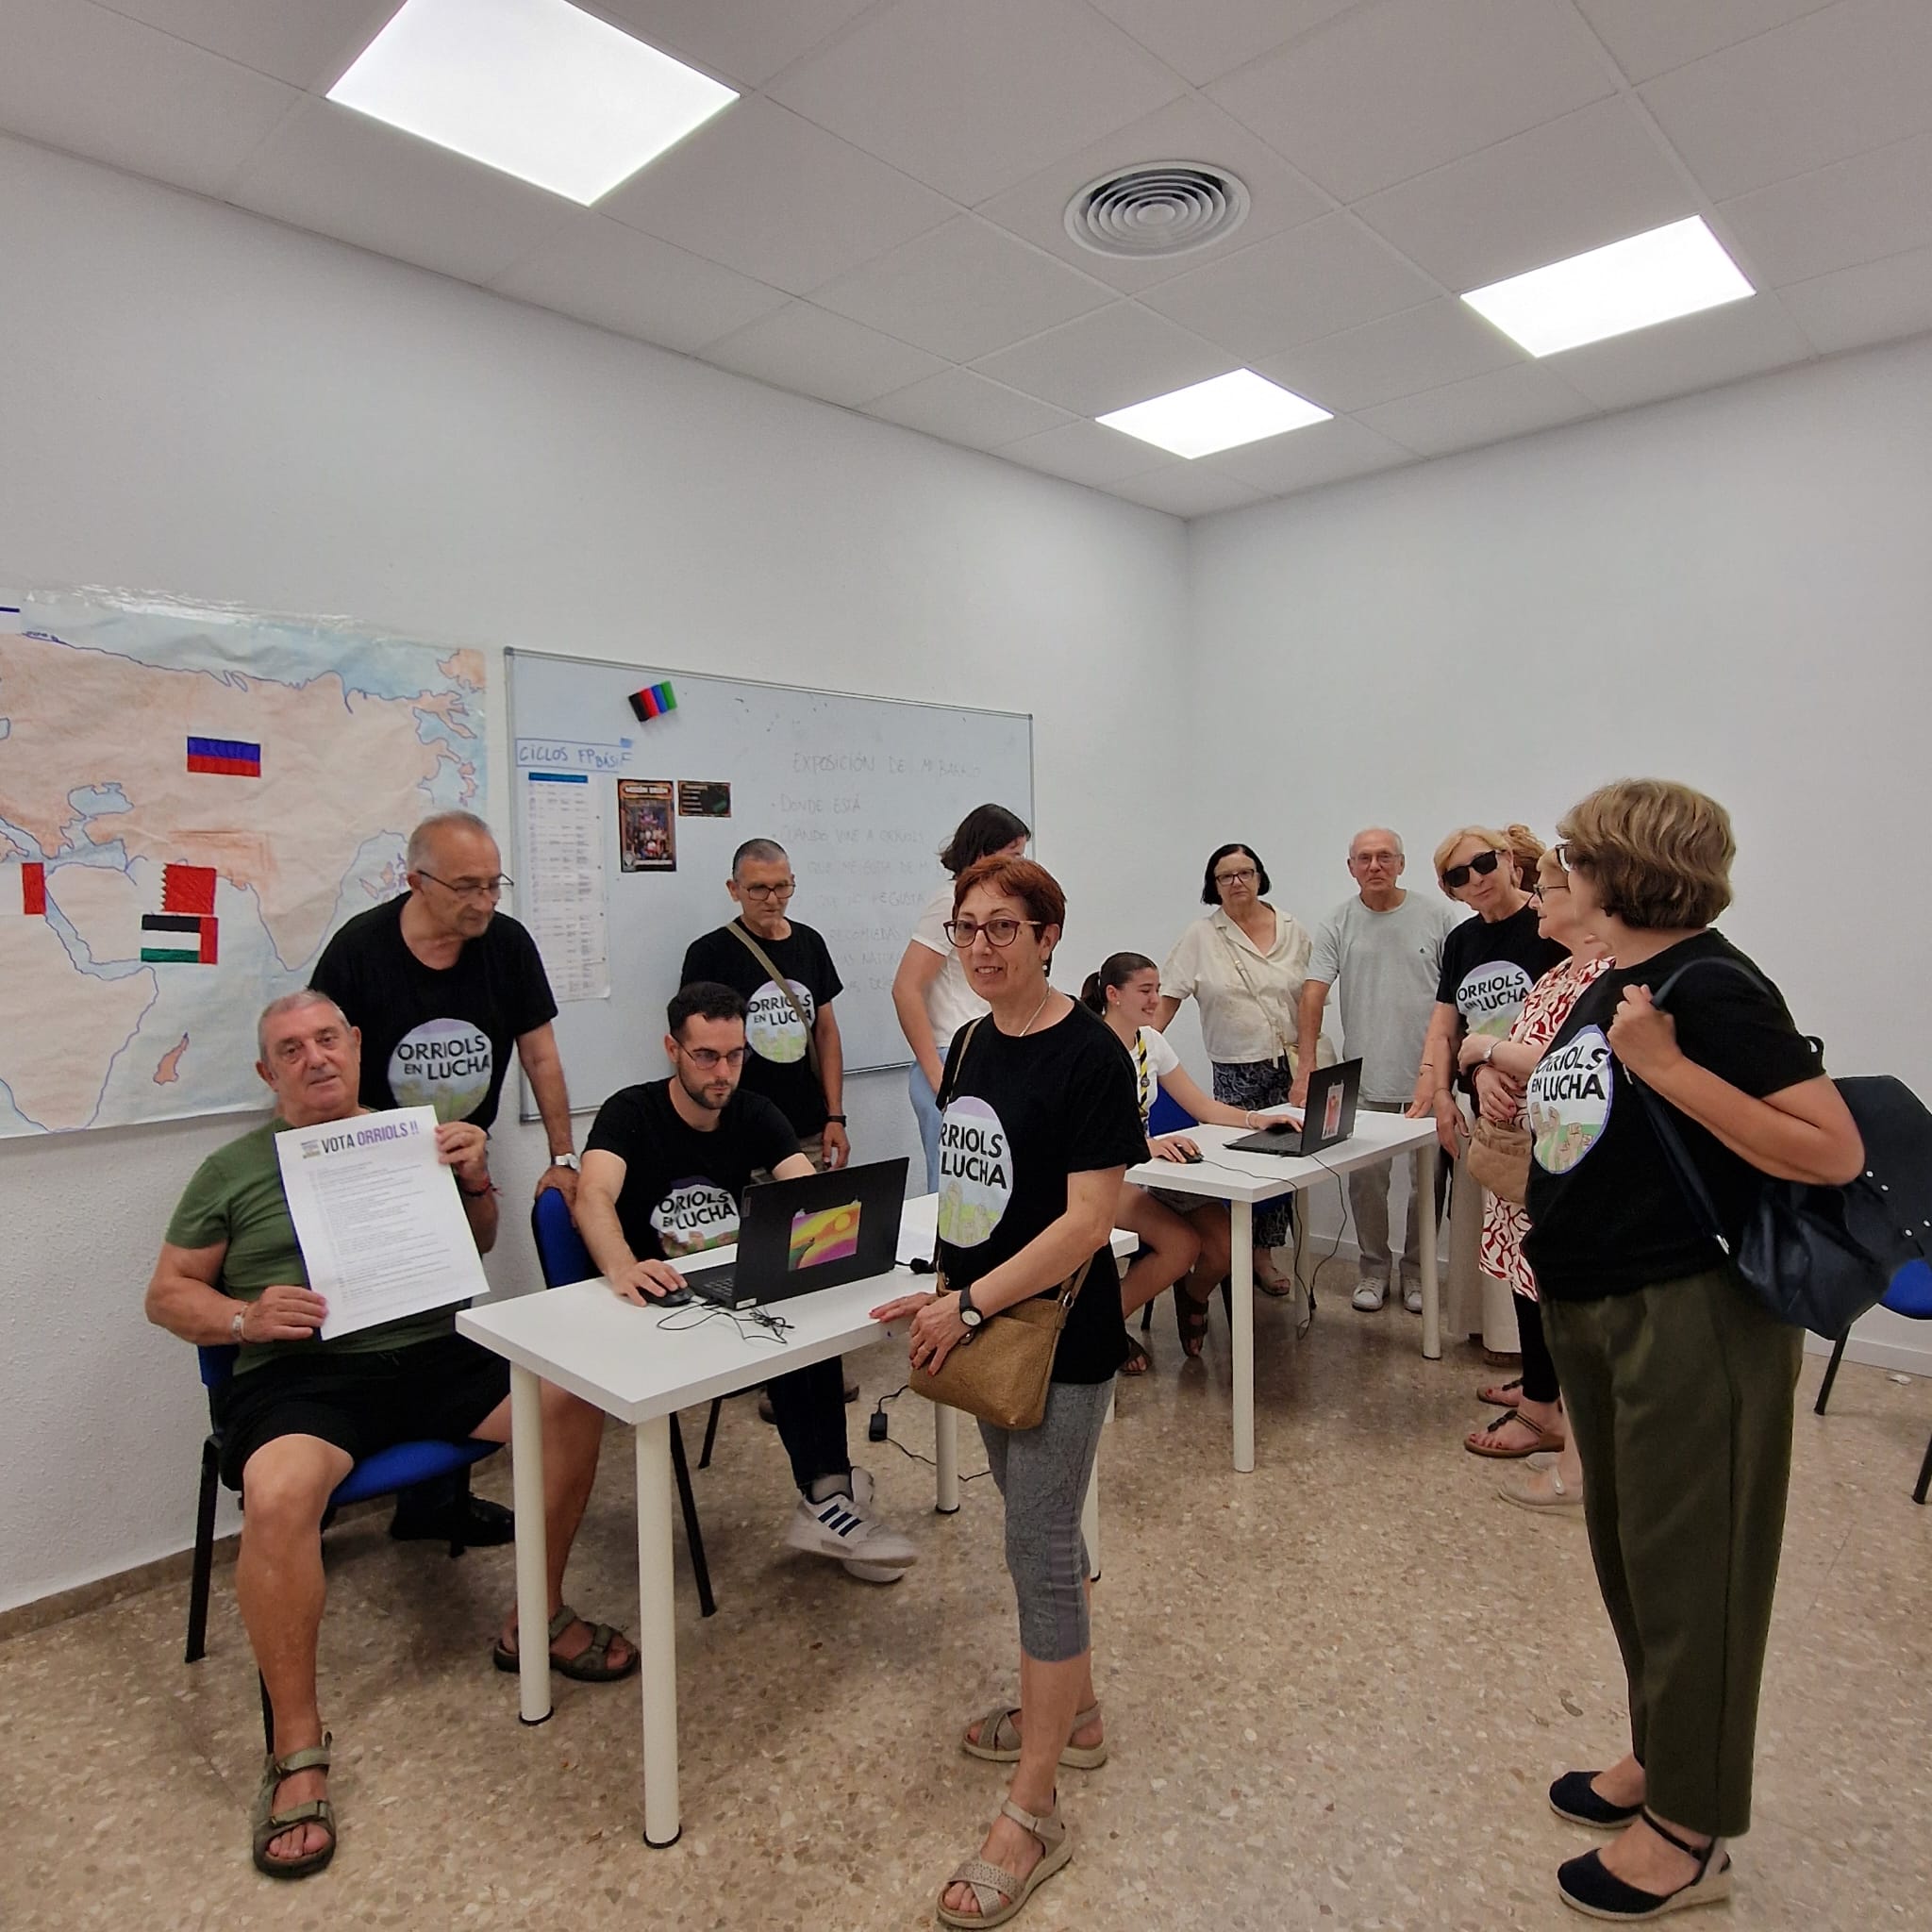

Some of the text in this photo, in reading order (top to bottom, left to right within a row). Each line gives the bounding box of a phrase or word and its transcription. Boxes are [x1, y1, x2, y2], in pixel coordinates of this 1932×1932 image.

[519, 746, 568, 762] CICLOS
[1457, 972, 1524, 1002] ORRIOLS
[1477, 987, 1529, 1011] LUCHA
[754, 1014, 766, 1024] EN
[397, 1035, 486, 1060] ORRIOLS
[404, 1055, 491, 1080] EN LUCHA
[1531, 1074, 1606, 1102] EN LUCHA
[321, 1134, 356, 1154] VOTA
[357, 1122, 408, 1147] ORRIOLS
[941, 1152, 1007, 1190] LUCHA
[676, 1203, 736, 1229] LUCHA
